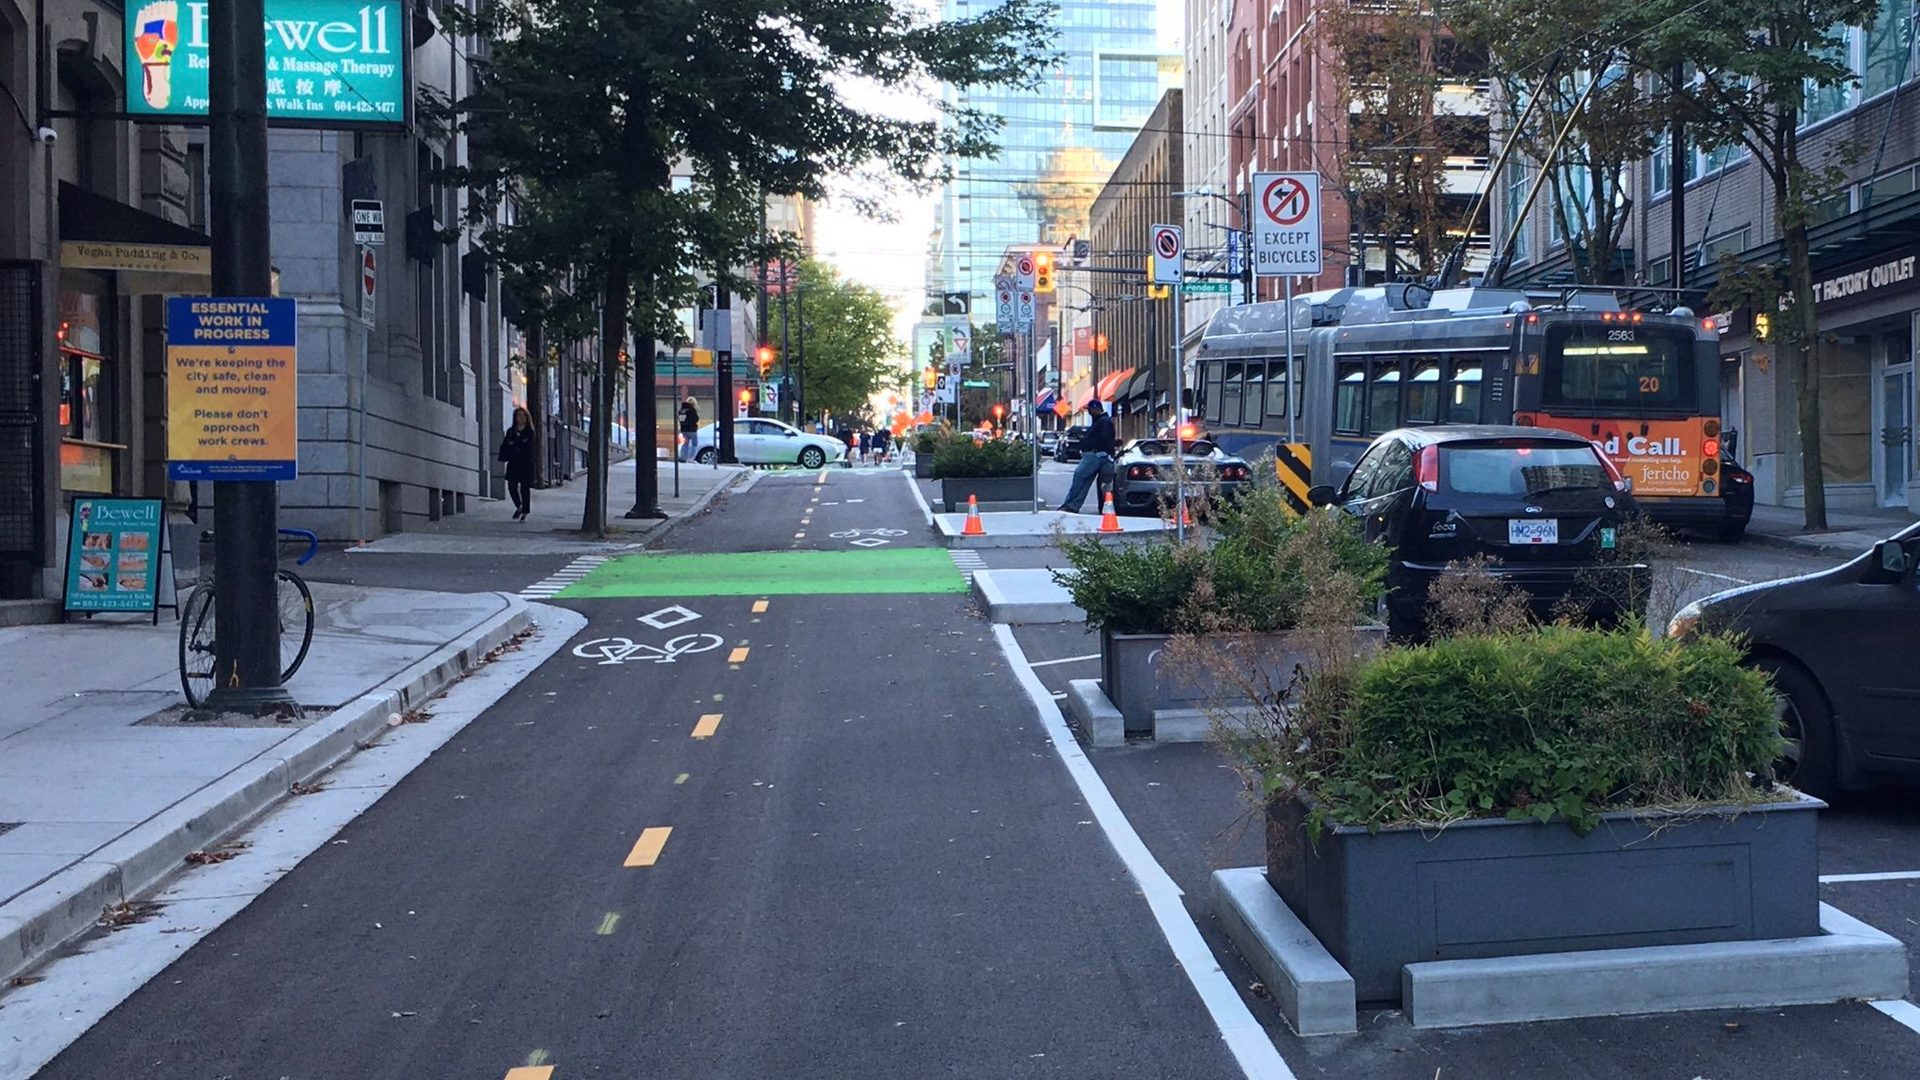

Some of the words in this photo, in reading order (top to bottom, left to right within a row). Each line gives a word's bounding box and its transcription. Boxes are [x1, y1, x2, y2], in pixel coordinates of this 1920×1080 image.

[267, 58, 279, 72] &
[283, 57, 338, 76] Massage
[341, 59, 395, 79] Therapy
[275, 99, 304, 111] Walk
[307, 101, 324, 111] Ins
[356, 211, 370, 223] ONE
[1265, 232, 1310, 245] EXCEPT
[76, 245, 112, 258] Vegan
[116, 248, 167, 261] Pudding
[169, 251, 178, 259] &
[182, 250, 199, 261] Co.
[1259, 250, 1317, 264] BICYCLES
[1823, 269, 1870, 301] FACTORY
[1871, 256, 1915, 288] OUTLET
[1186, 283, 1215, 292] Pender
[1218, 283, 1228, 292] St
[191, 302, 270, 314] ESSENTIAL
[198, 315, 243, 327] WORK
[247, 315, 262, 327] IN
[194, 328, 270, 340] PROGRESS
[1607, 330, 1635, 341] 2563
[175, 358, 211, 368] We're
[215, 357, 263, 369] keeping
[266, 358, 286, 368] the
[186, 371, 208, 382] city
[212, 371, 240, 382] safe,
[244, 371, 276, 381] clean
[196, 384, 218, 395] and
[222, 384, 270, 396] moving.
[1639, 376, 1659, 393] 20
[194, 409, 233, 419] Please
[236, 409, 268, 419] don't
[202, 423, 260, 434] approach
[197, 436, 227, 446] work
[231, 437, 269, 446] crews.
[1627, 436, 1687, 456] Call.
[96, 505, 155, 520] Bewell
